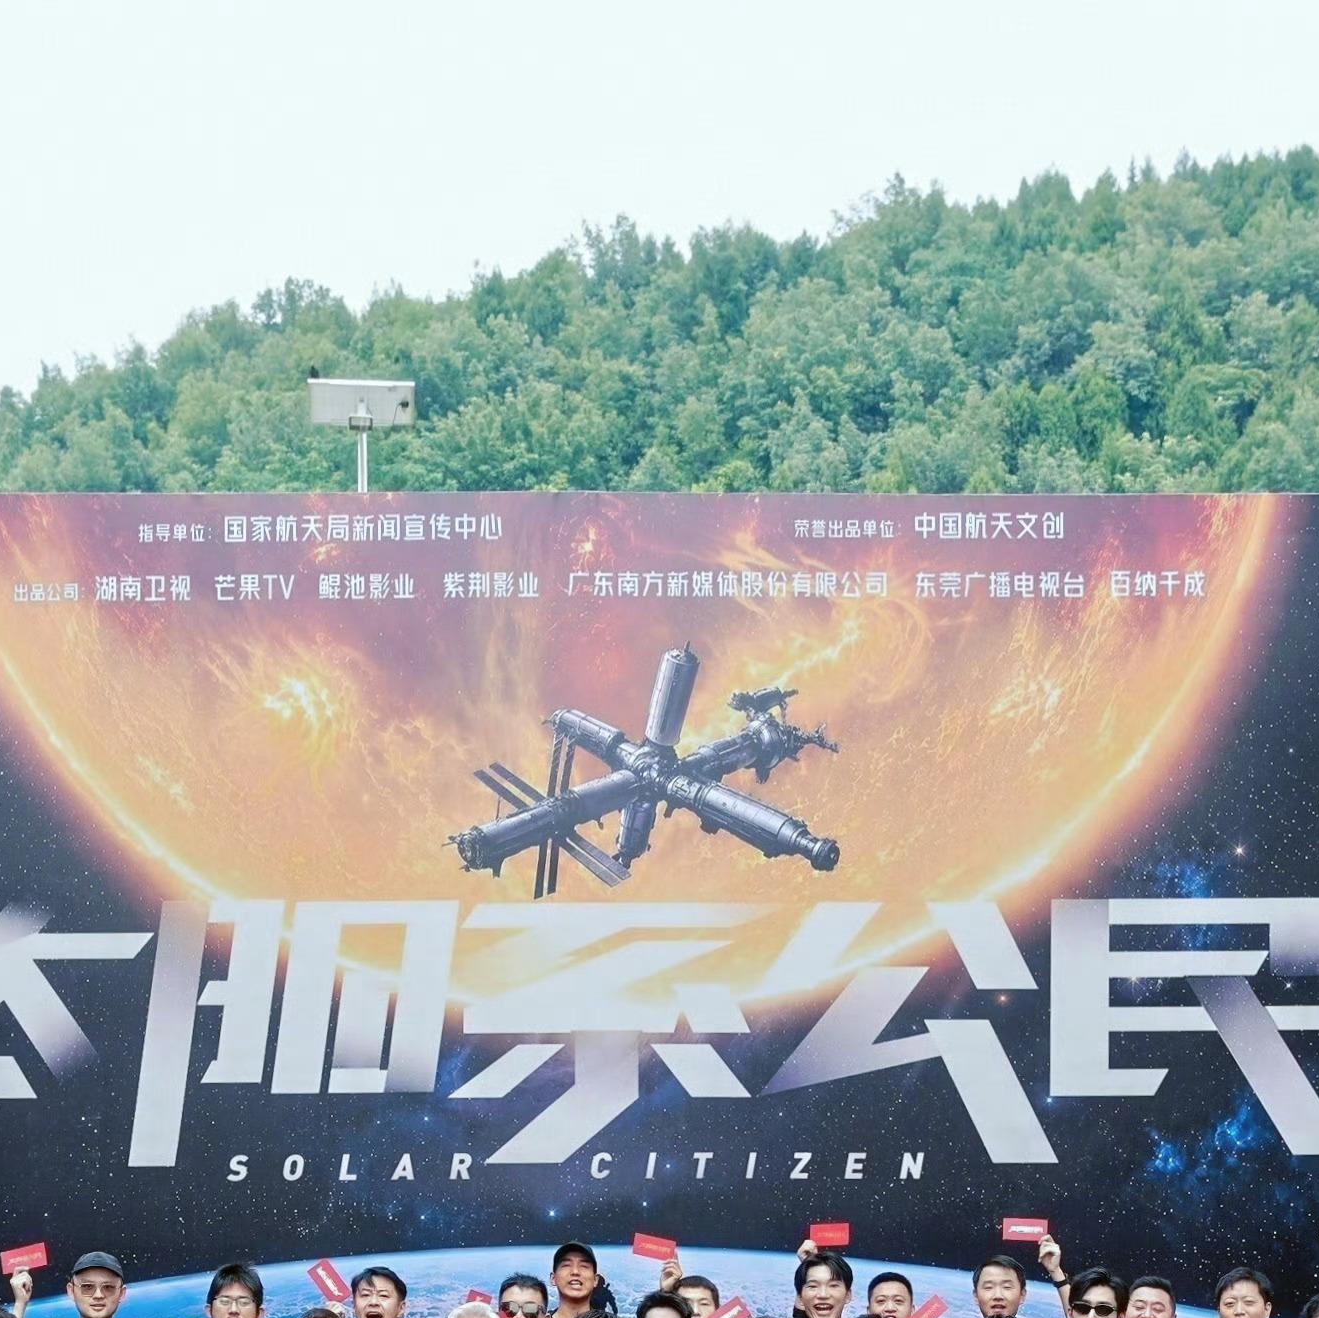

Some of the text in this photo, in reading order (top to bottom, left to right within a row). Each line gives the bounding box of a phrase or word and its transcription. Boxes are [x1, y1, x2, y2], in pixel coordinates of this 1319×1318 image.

[224, 513, 503, 543] 国家航天局新闻宣传中心
[914, 512, 1065, 540] 中国航天文创
[95, 575, 191, 601] 湖南卫视
[214, 574, 295, 601] 芒果TV
[318, 573, 415, 599] 鲲池影业
[443, 571, 539, 598] 紫荆影业
[568, 571, 888, 598] 广东南方新媒体股份有限公司
[915, 571, 1086, 598] 东莞广播电视台
[1109, 570, 1206, 598] 百纳千成
[226, 1151, 926, 1181] SOLAR CITIZEN
